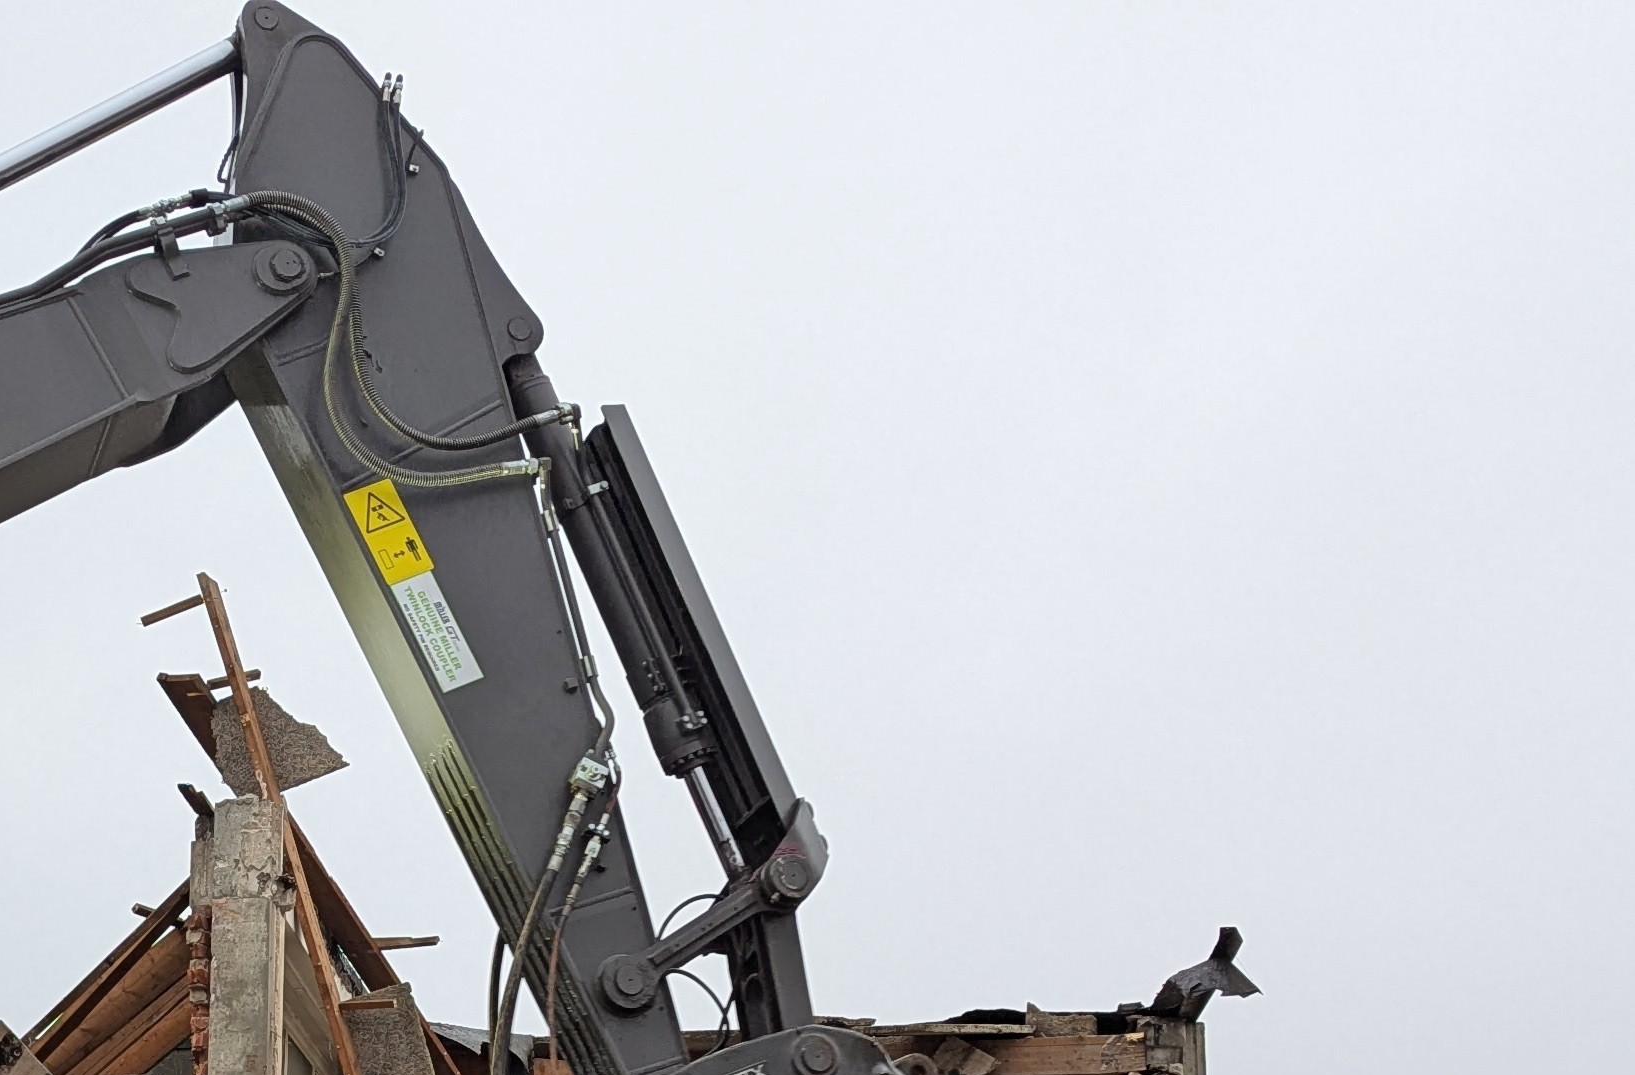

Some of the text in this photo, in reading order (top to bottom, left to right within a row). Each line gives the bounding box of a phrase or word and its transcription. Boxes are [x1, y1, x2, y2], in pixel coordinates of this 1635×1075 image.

[404, 586, 457, 682] TWINLOCK COUPLER
[408, 613, 421, 633] SAFETY
[417, 591, 462, 670] GENUINE MILLER
